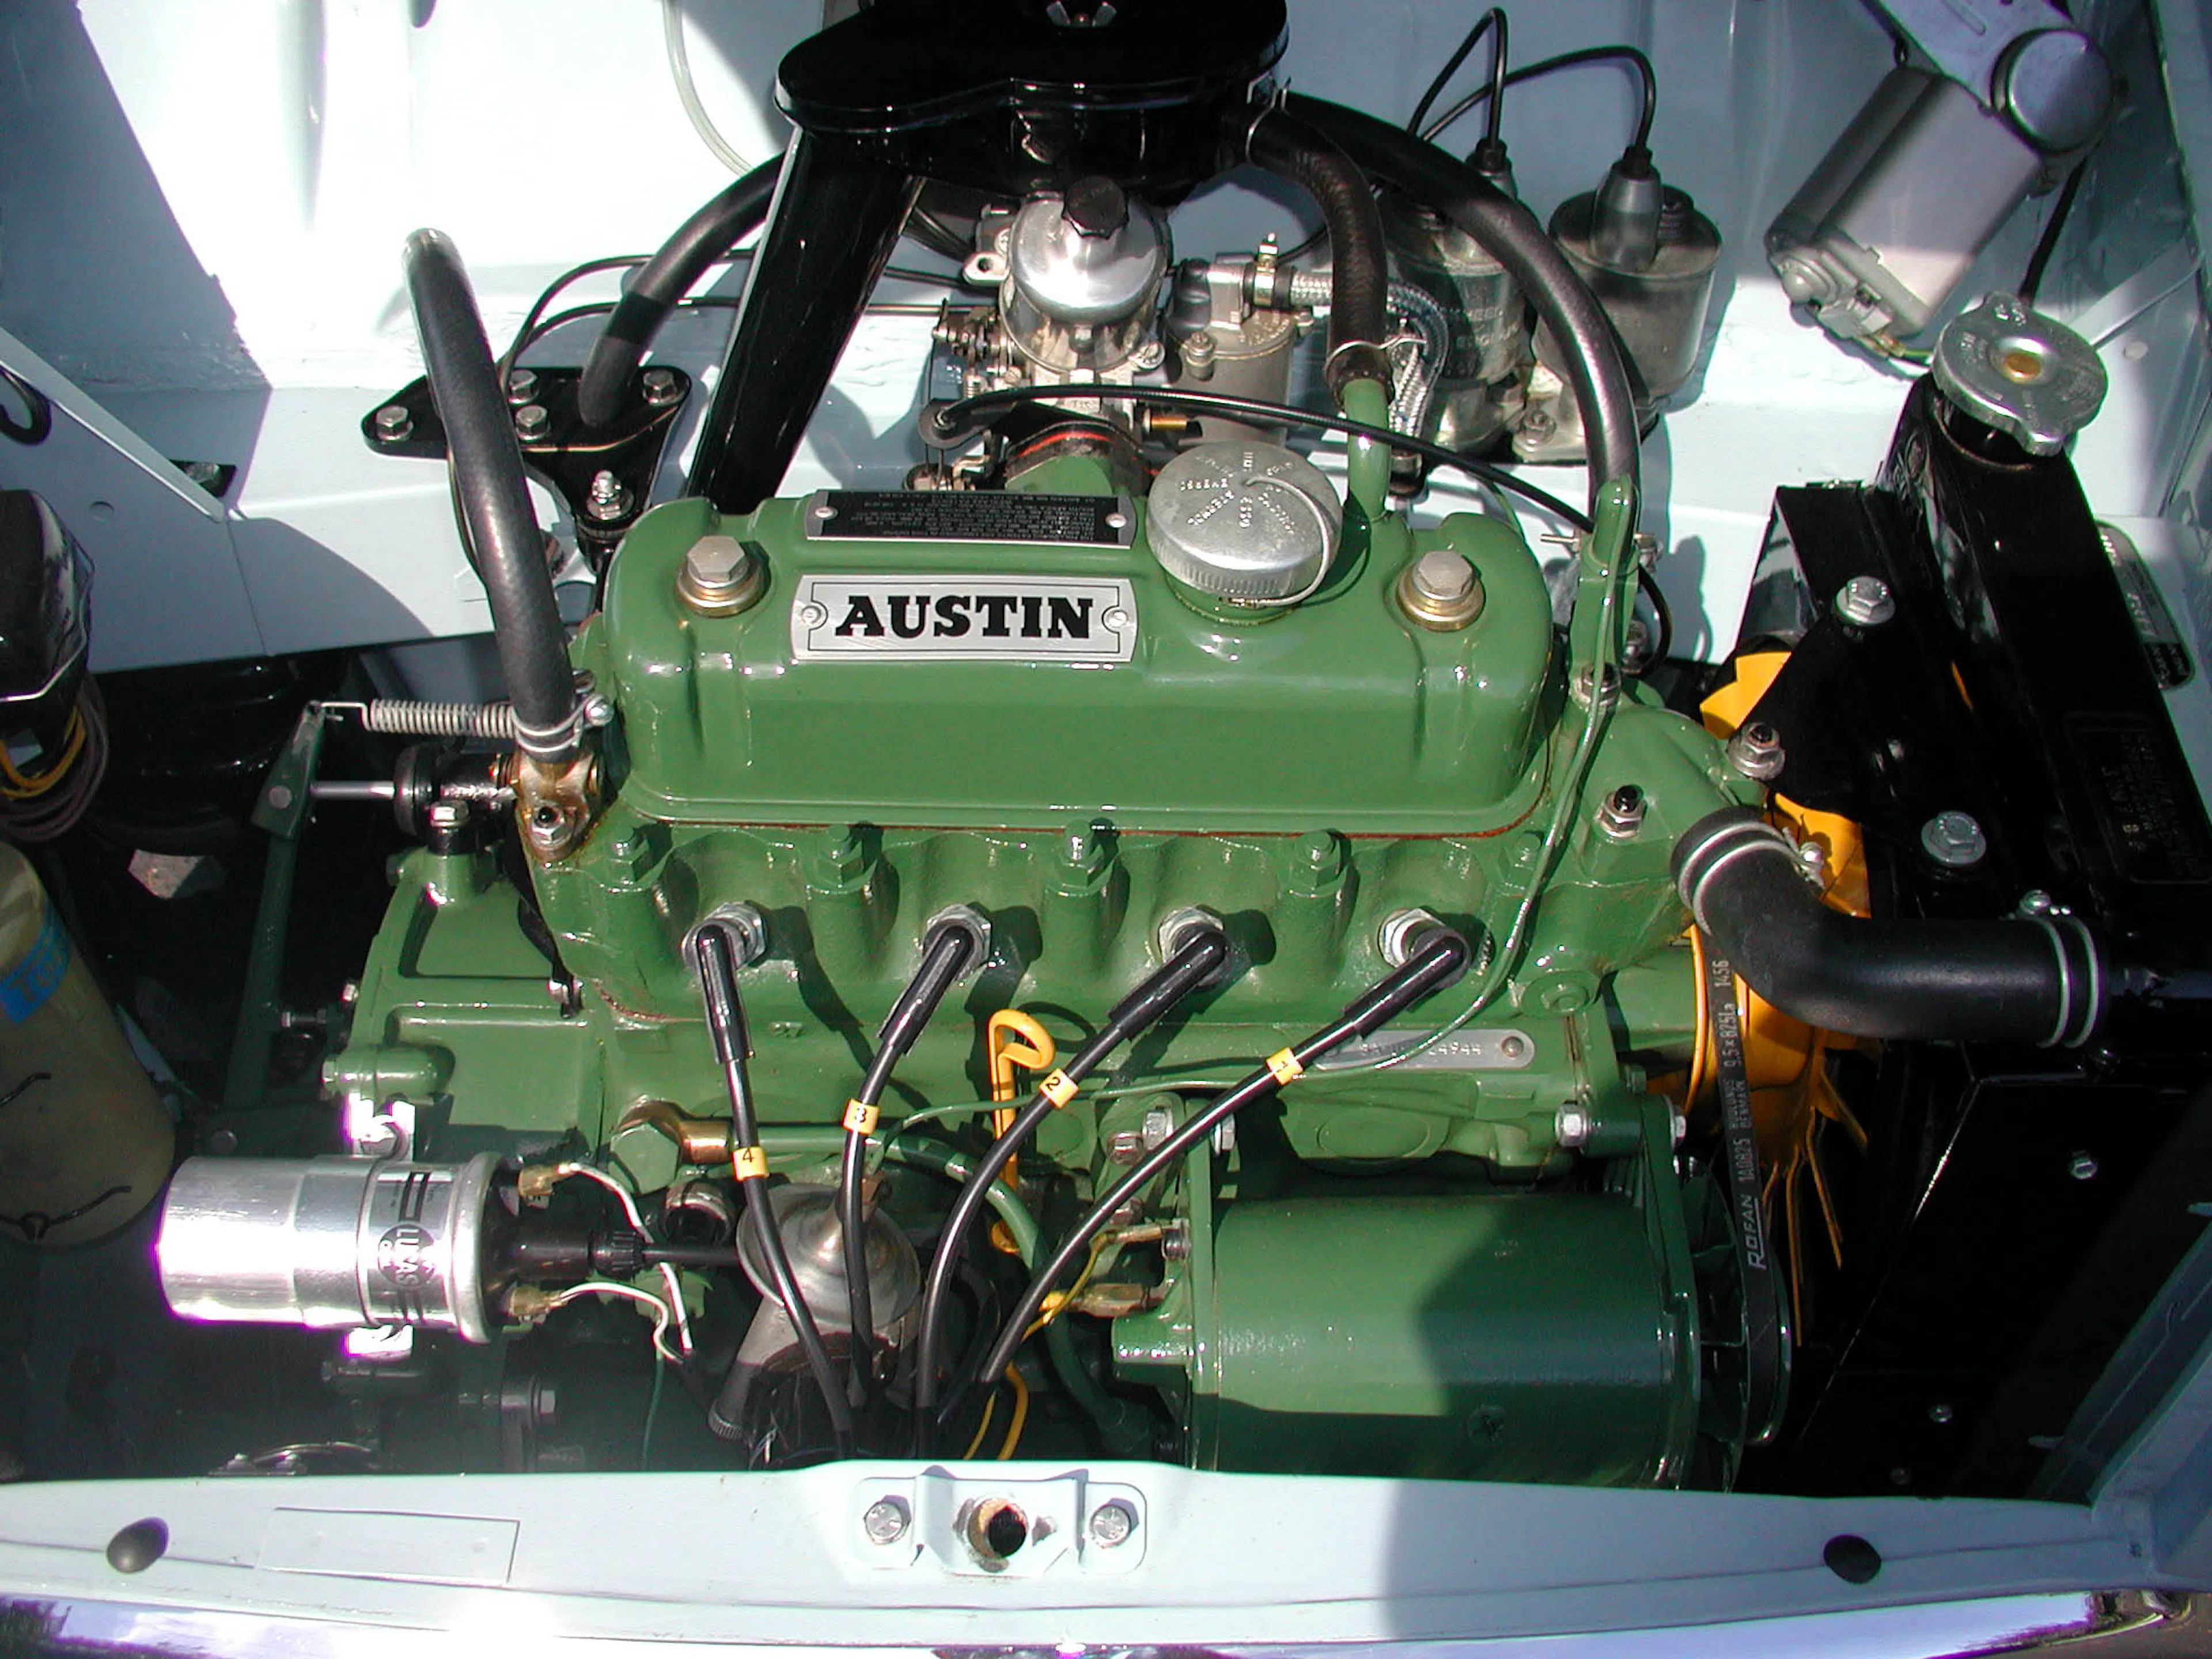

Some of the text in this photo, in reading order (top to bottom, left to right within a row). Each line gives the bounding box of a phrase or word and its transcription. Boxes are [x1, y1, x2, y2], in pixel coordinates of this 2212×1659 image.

[835, 595, 1093, 639] AUSTIN
[1711, 959, 1730, 988] 1456
[1046, 1077, 1061, 1092] 2
[854, 1107, 868, 1123] 3
[742, 1146, 755, 1163] 4
[1743, 1193, 1767, 1271] ROFAN
